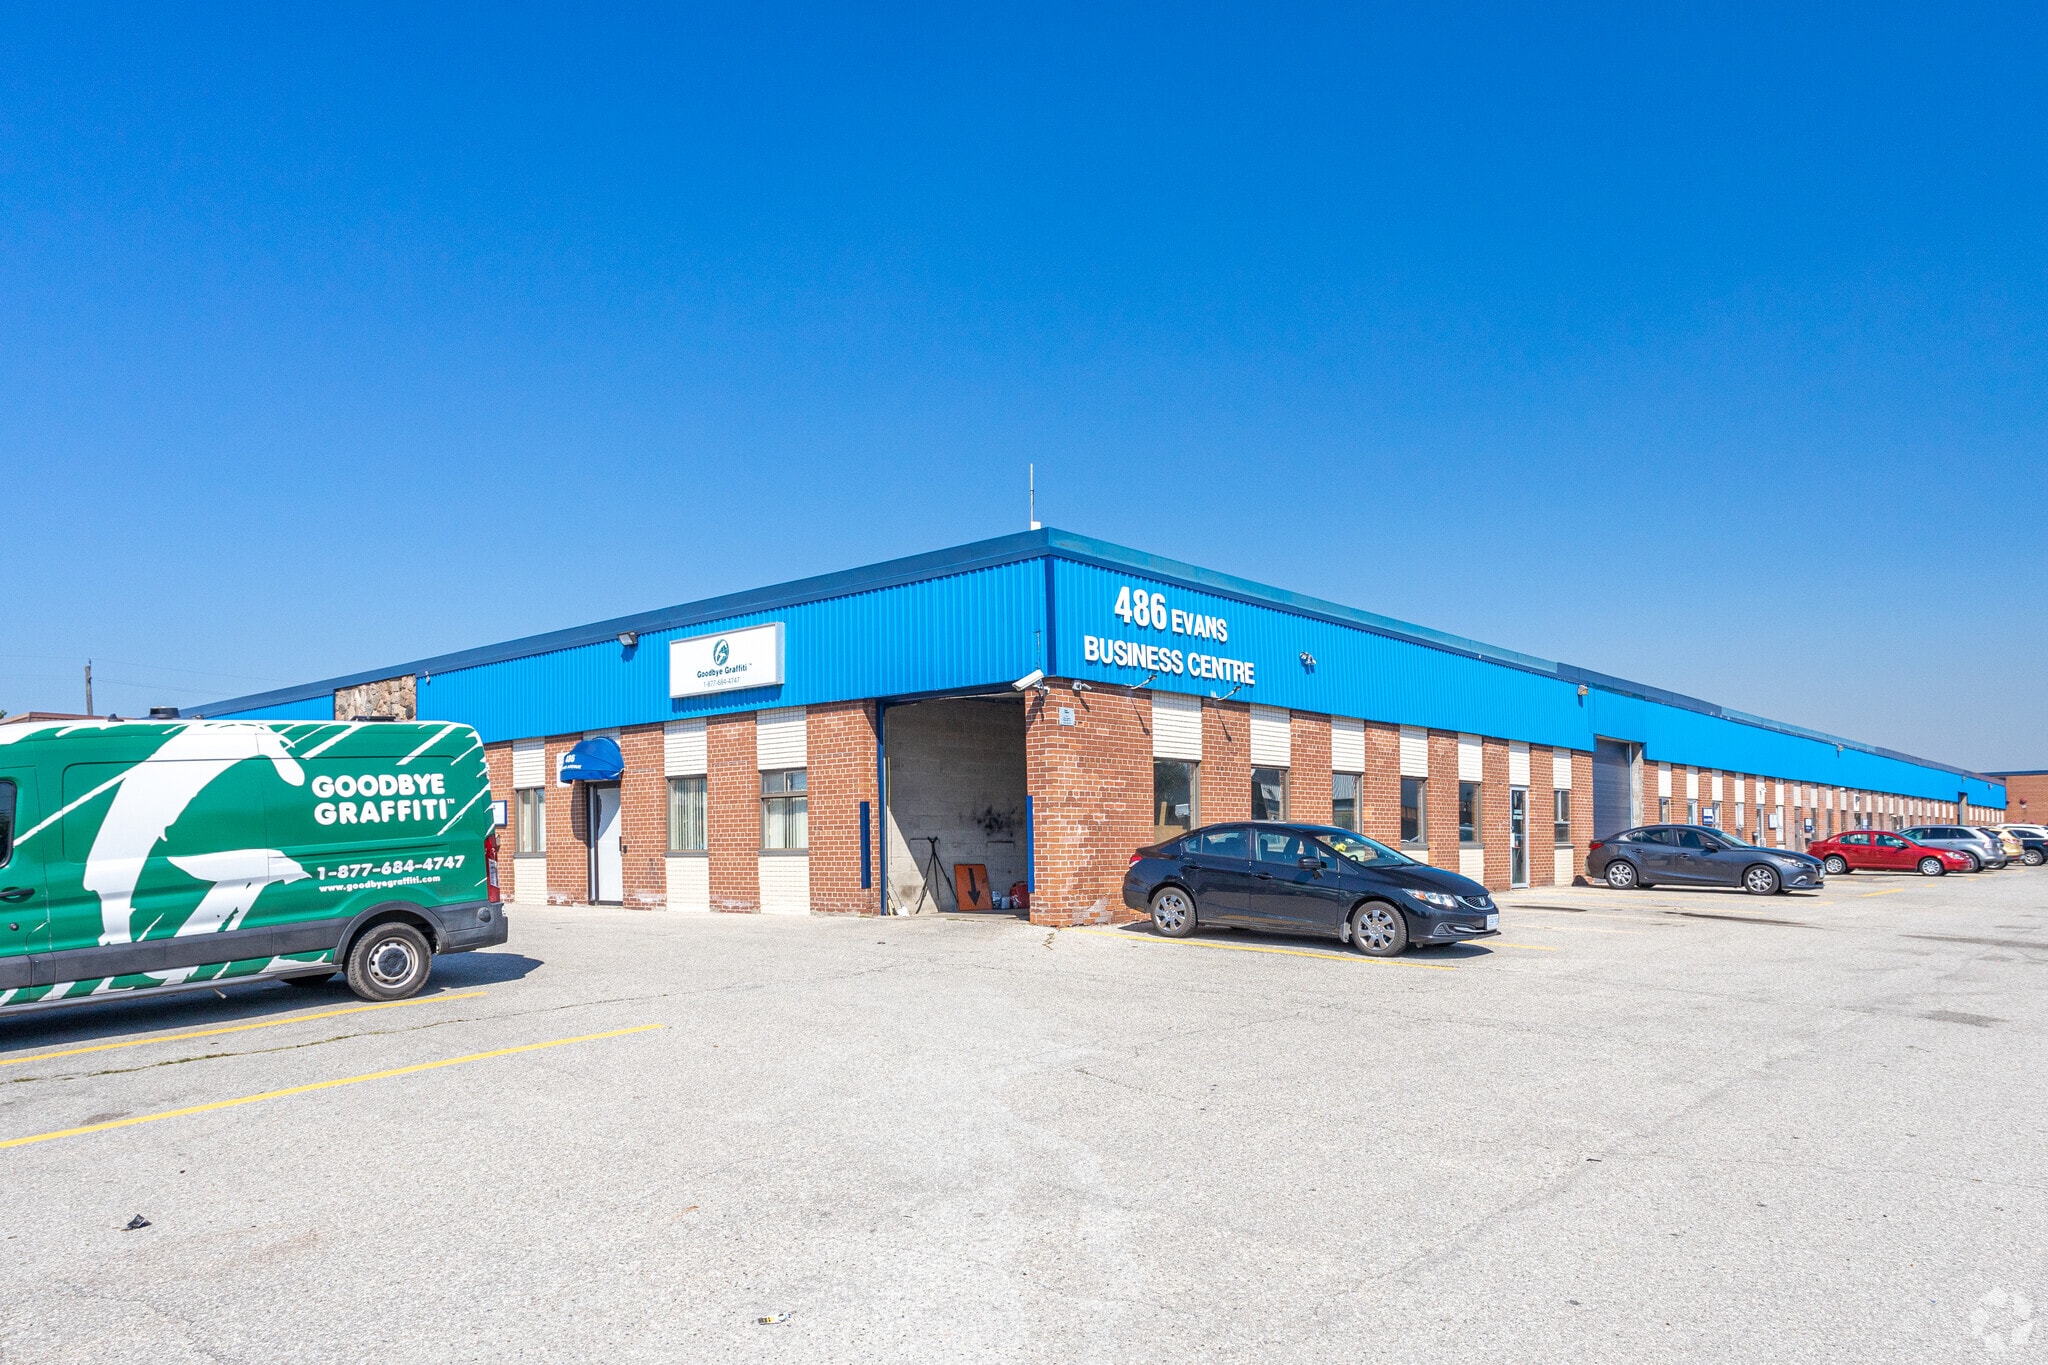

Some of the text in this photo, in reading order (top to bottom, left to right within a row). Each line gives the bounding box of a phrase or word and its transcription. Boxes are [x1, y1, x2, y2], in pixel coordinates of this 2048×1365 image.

[1114, 586, 1228, 642] 486 EVANS
[697, 664, 747, 678] Goodbye Graffiti
[1084, 635, 1256, 685] BUSINESS CENTRE
[311, 773, 445, 798] GOODBYE
[314, 798, 447, 825] GRAFFITI
[317, 855, 465, 880] 1-877-684-4747
[318, 876, 441, 892] www.goodbyegraffiti.com
